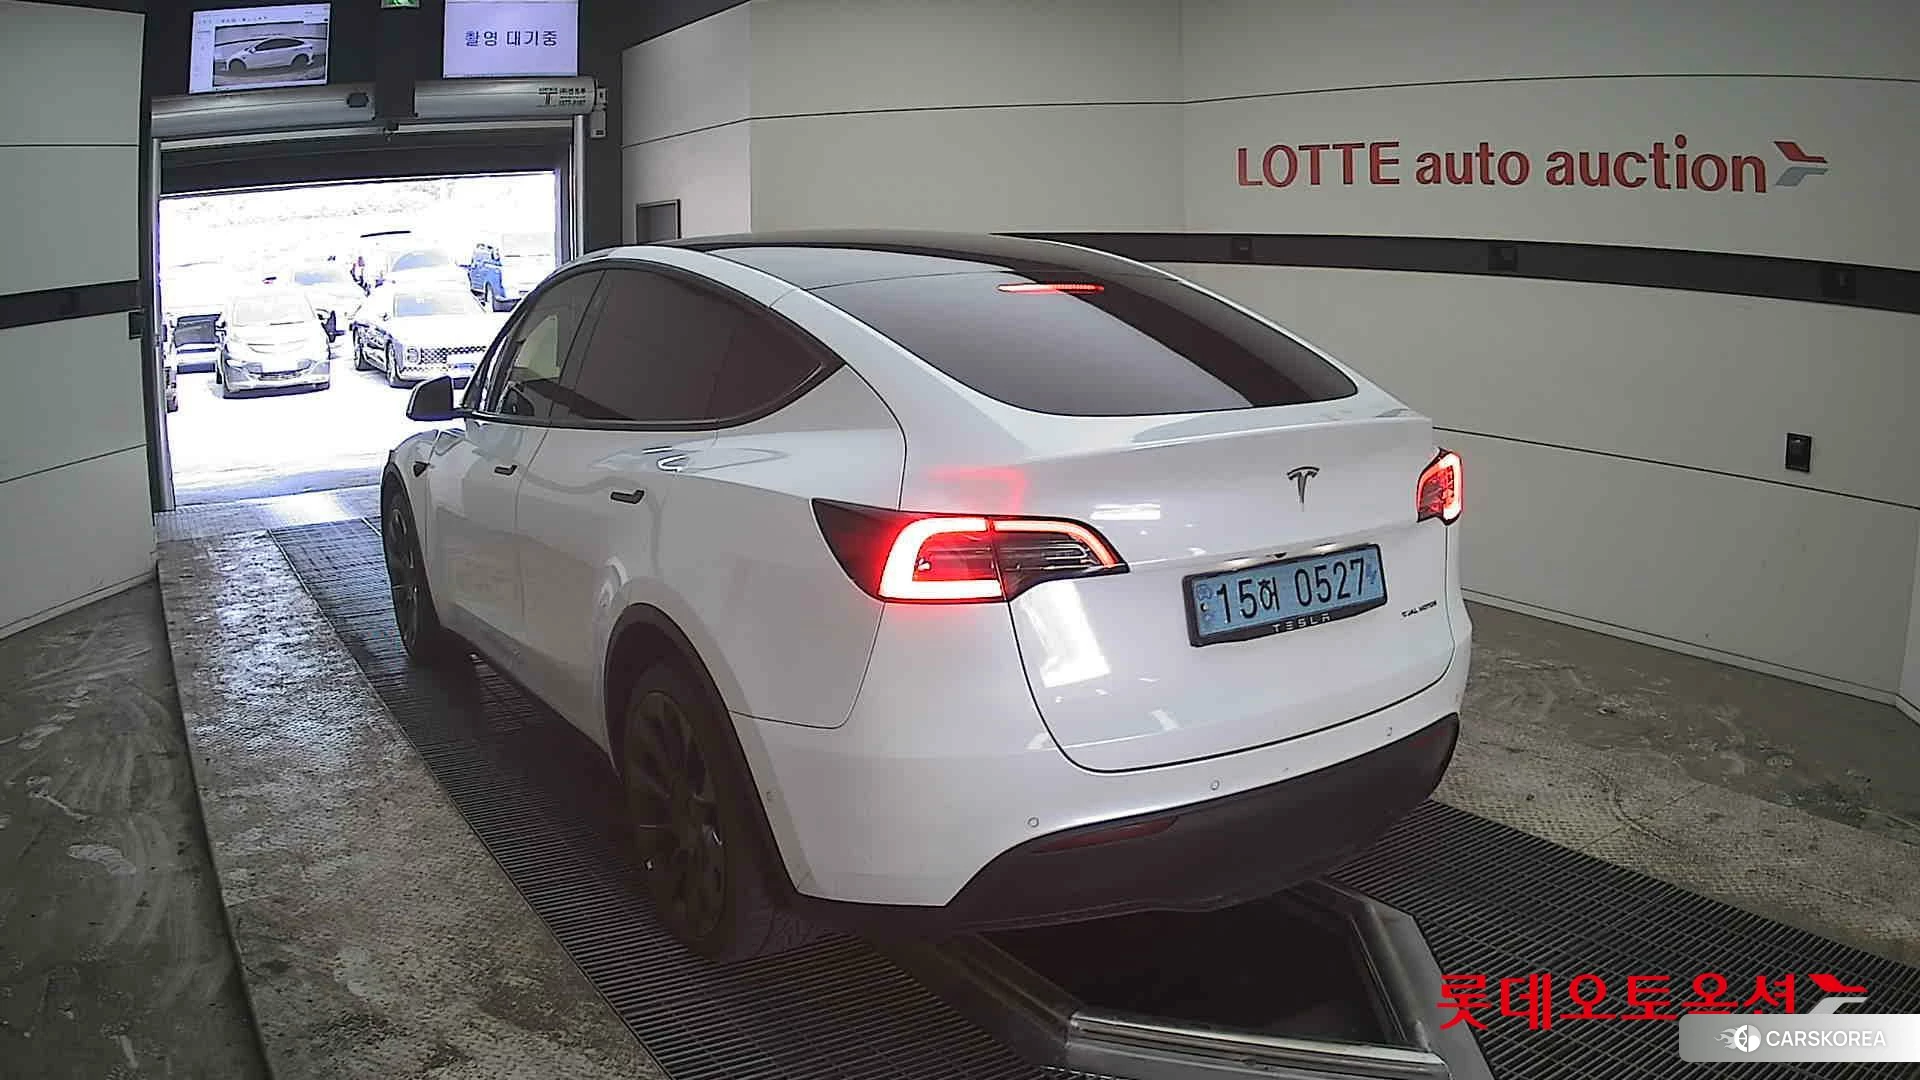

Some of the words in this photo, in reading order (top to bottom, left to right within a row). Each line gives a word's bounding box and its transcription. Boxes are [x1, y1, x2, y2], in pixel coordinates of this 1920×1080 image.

[506, 30, 558, 47] 대기중
[1236, 141, 1400, 188] LOTTE
[1415, 142, 1531, 186] auto
[1545, 134, 1767, 194] auction
[1216, 577, 1280, 624] 15허
[1294, 557, 1364, 607] 0527
[1272, 613, 1330, 633] TESLA
